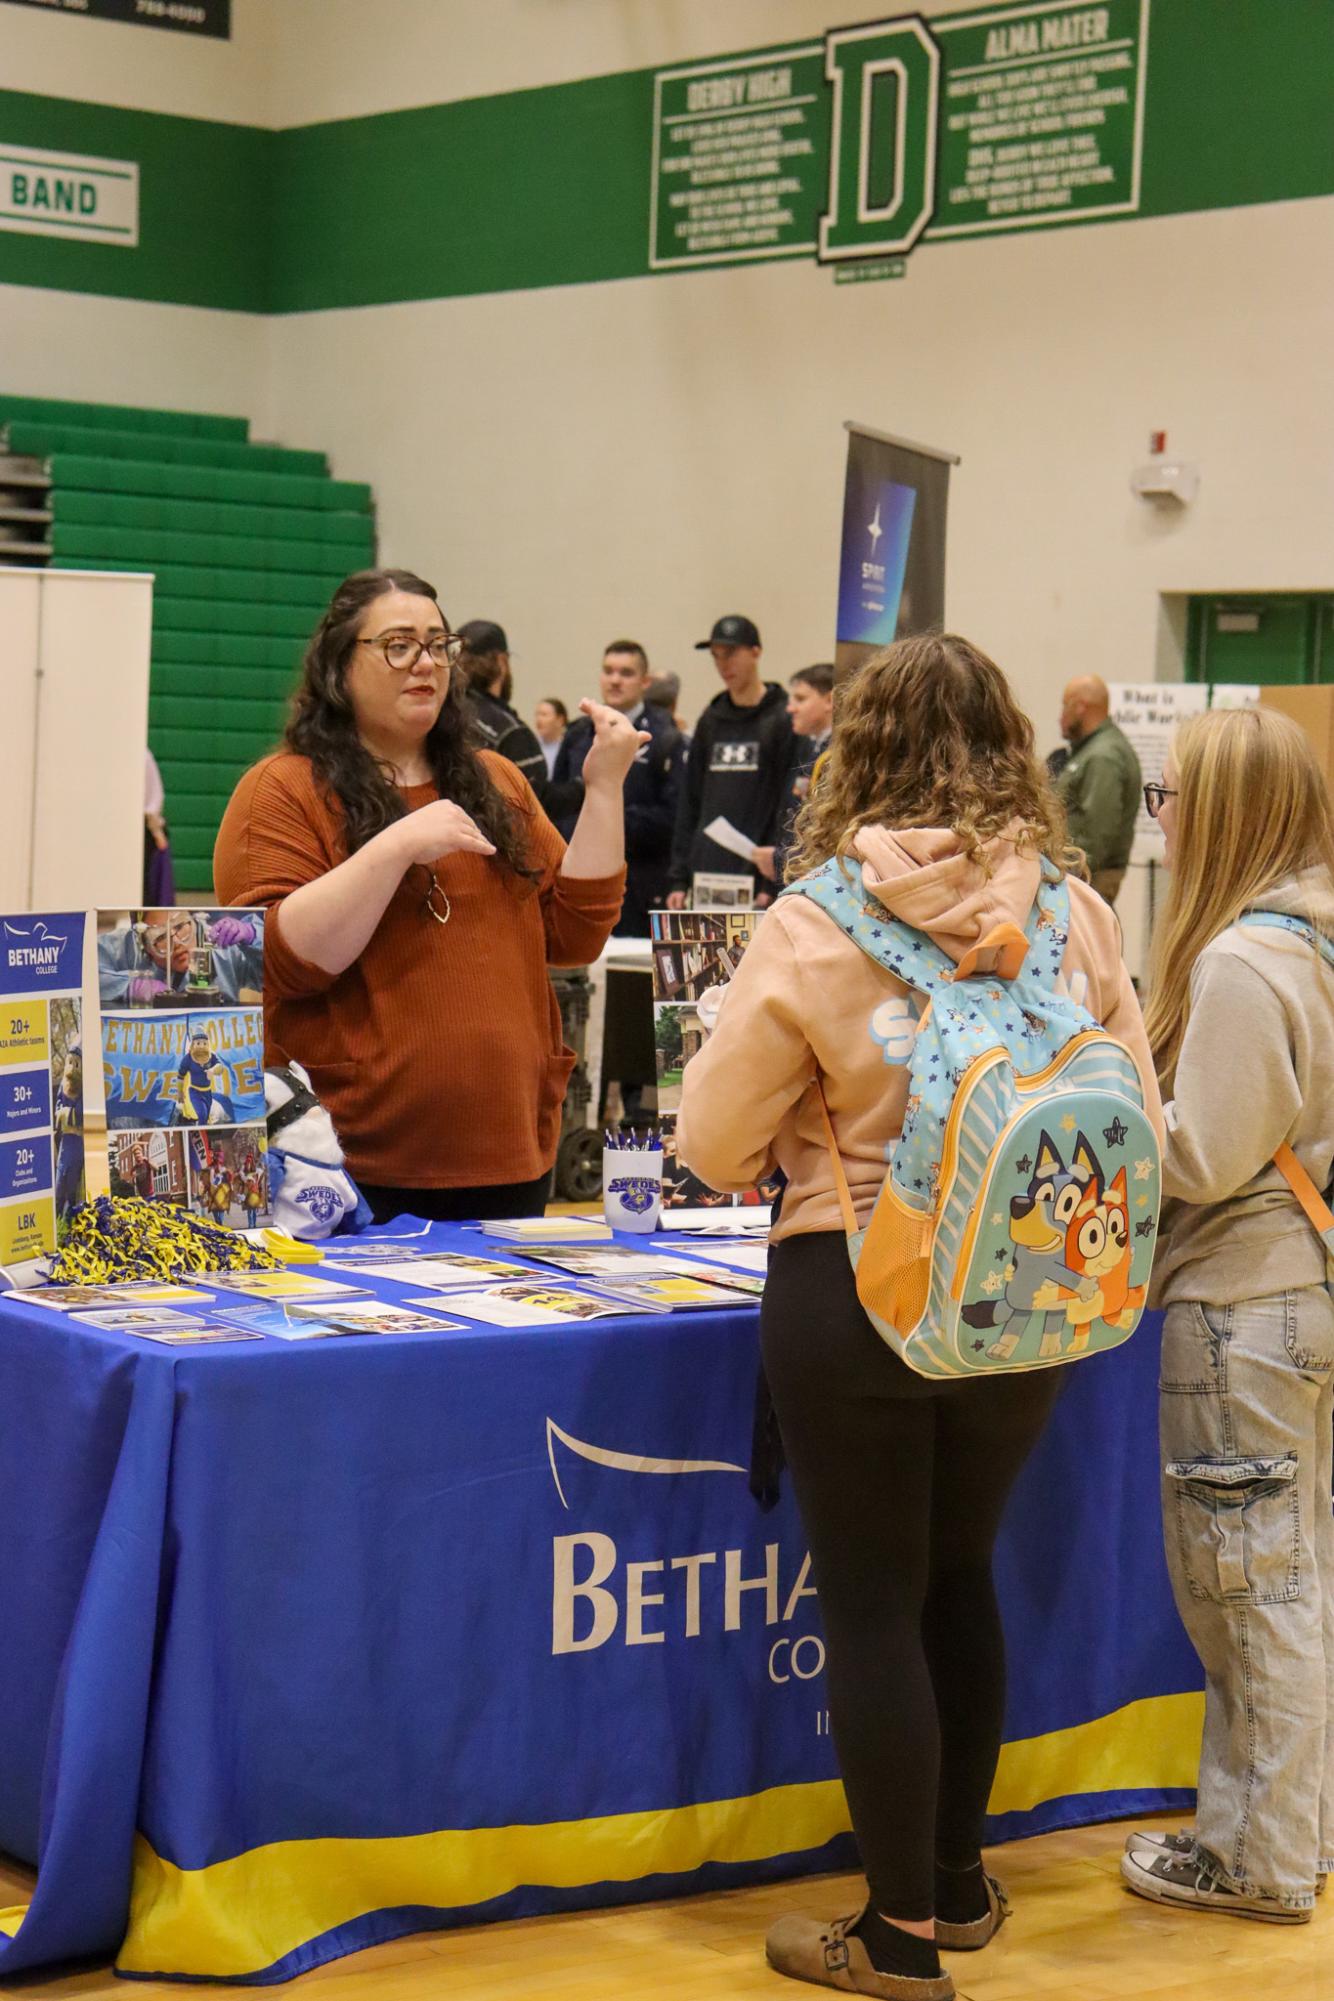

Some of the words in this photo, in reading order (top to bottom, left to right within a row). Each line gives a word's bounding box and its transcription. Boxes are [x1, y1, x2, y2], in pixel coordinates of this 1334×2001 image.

[985, 21, 1039, 61] ALMA
[1041, 8, 1108, 50] MATER
[817, 13, 941, 266] D
[11, 173, 97, 215] BAND
[8, 947, 60, 967] BETHANY
[36, 966, 58, 975] COLLEGE
[10, 1020, 30, 1035] 20+
[101, 1018, 187, 1056] ETHANY
[14, 1086, 32, 1102] 30+
[16, 1149, 35, 1166] 20+
[18, 1212, 36, 1231] LBK
[551, 1531, 819, 1656] BETHA
